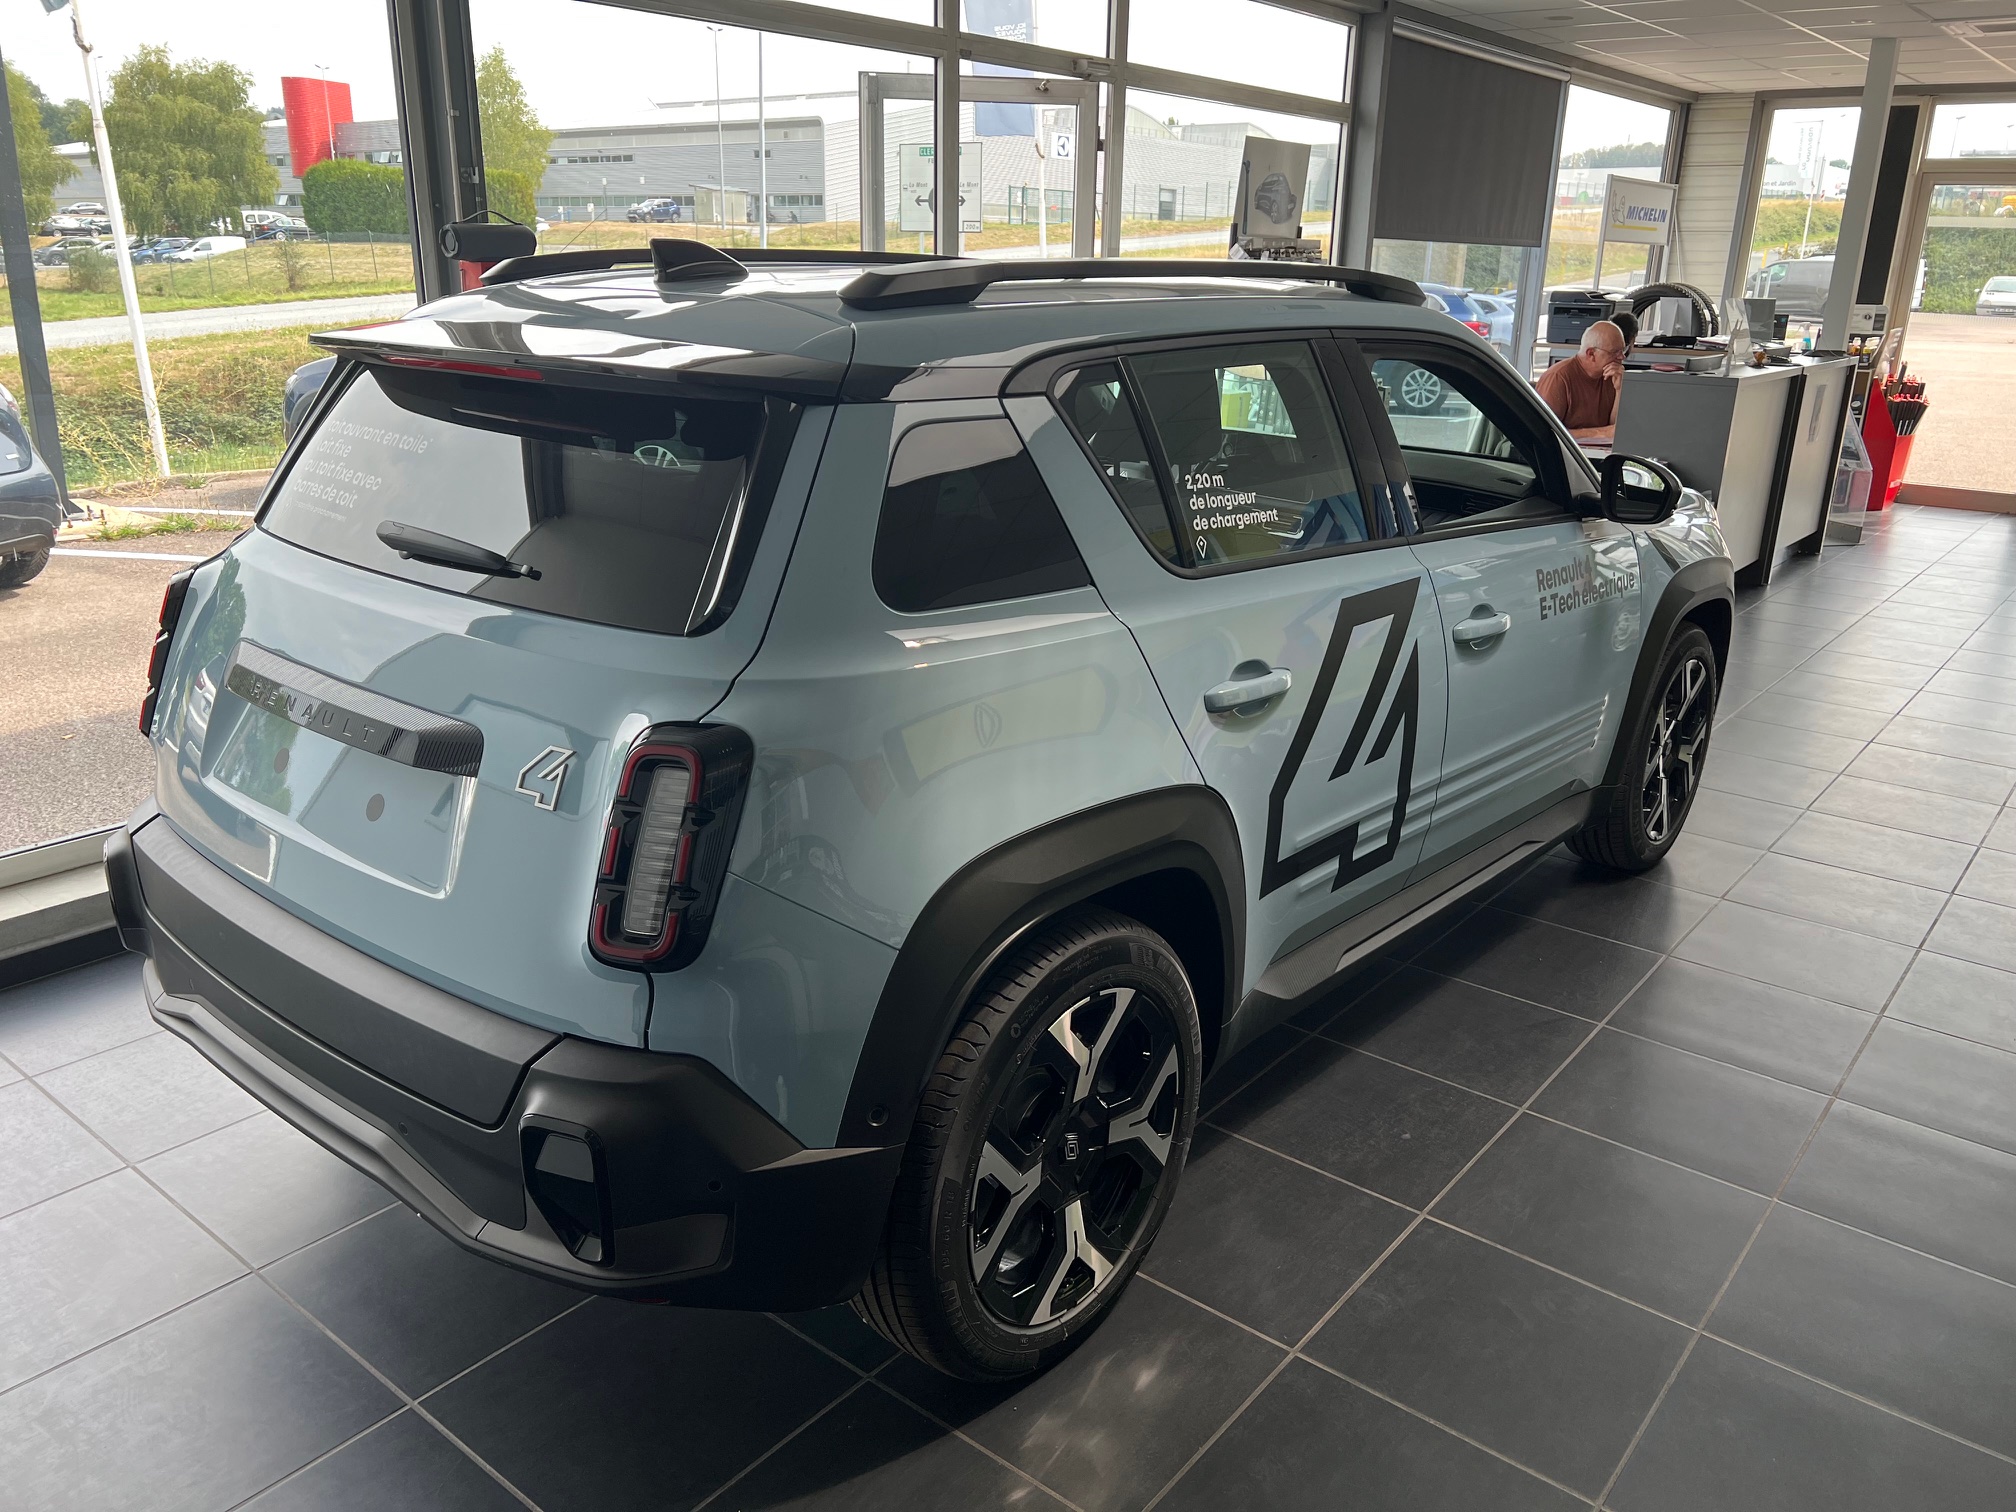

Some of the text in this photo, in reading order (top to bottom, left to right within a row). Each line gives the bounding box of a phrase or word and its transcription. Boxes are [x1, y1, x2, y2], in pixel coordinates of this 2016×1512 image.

[1626, 206, 1668, 223] MICHELIN
[317, 437, 352, 458] toit fixe
[328, 418, 345, 434] toit
[344, 423, 383, 443] ouvrant
[383, 431, 400, 447] en
[304, 458, 382, 491] ou toit fixe avec
[1184, 473, 1225, 491] 2,20 m
[293, 476, 325, 498] barres
[322, 483, 338, 502] de
[336, 489, 358, 509] toit
[1189, 492, 1256, 510] de longueur
[1193, 508, 1279, 531] de chargement
[1536, 554, 1593, 592] Renault 4
[1539, 585, 1581, 620] E-Tech
[250, 675, 375, 743] RENAULT
[514, 744, 577, 811] 4
